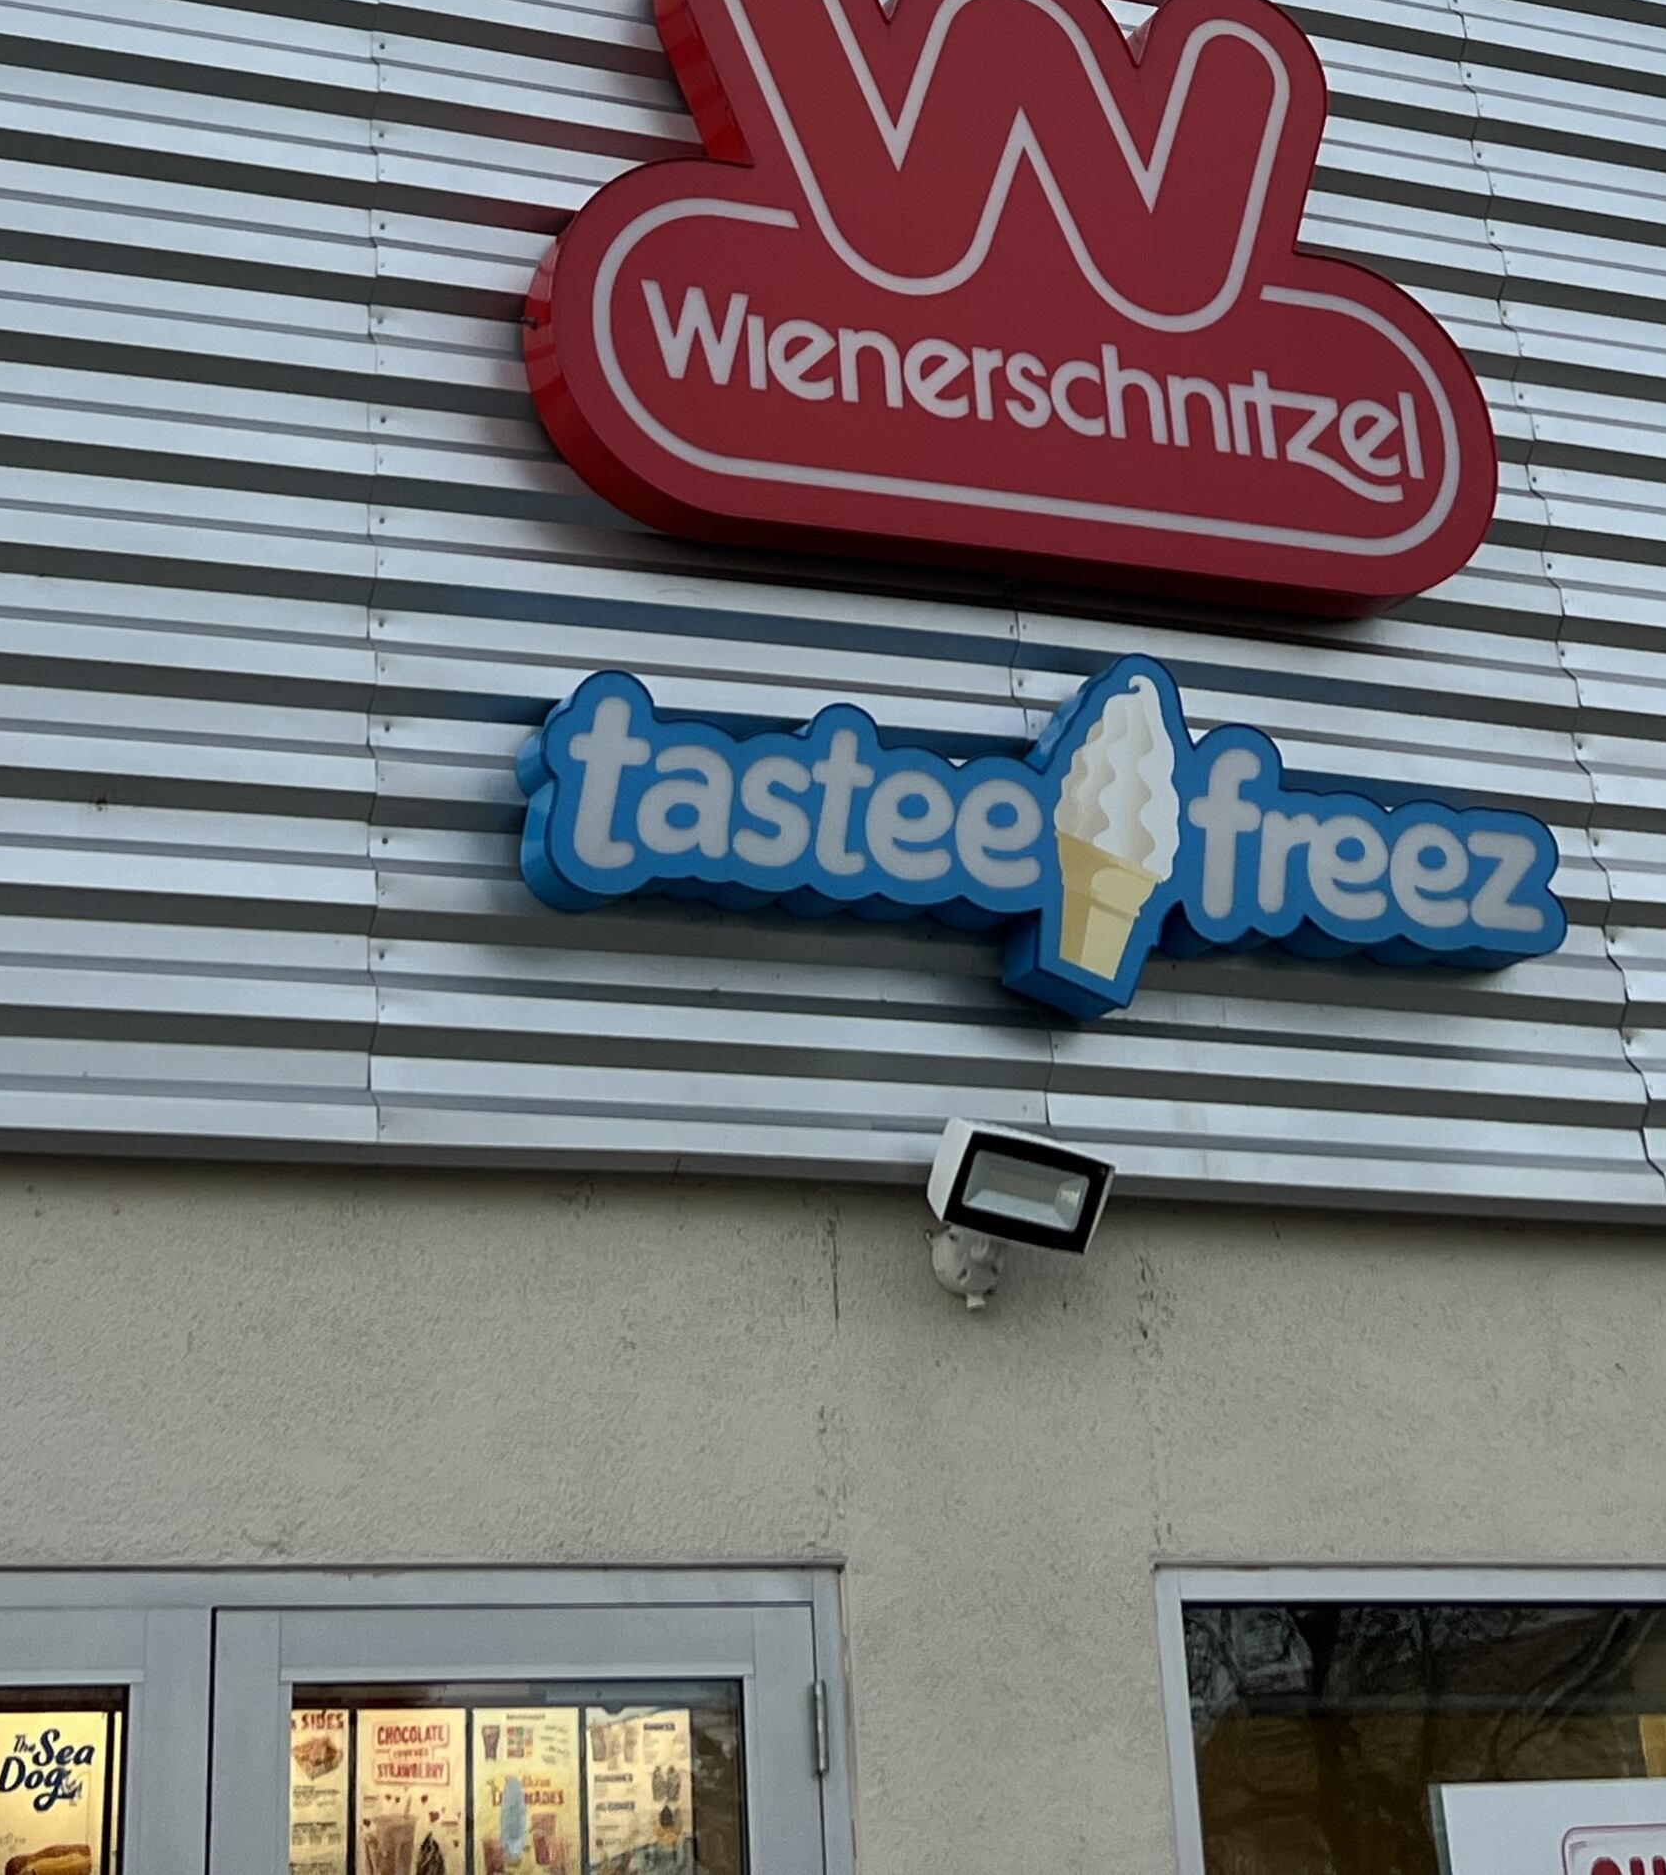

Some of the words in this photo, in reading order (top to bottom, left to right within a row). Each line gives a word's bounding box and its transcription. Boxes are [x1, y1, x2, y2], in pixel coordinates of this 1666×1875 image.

[640, 278, 1425, 503] Wienerschnitzel
[569, 695, 1042, 889] tastee
[1187, 748, 1546, 932] freez
[301, 1713, 344, 1730] SIDES
[377, 1725, 445, 1746] CHOCOLATE
[14, 1734, 36, 1753] The
[32, 1728, 95, 1766] Sea
[377, 1762, 445, 1778] STRAWBERRY
